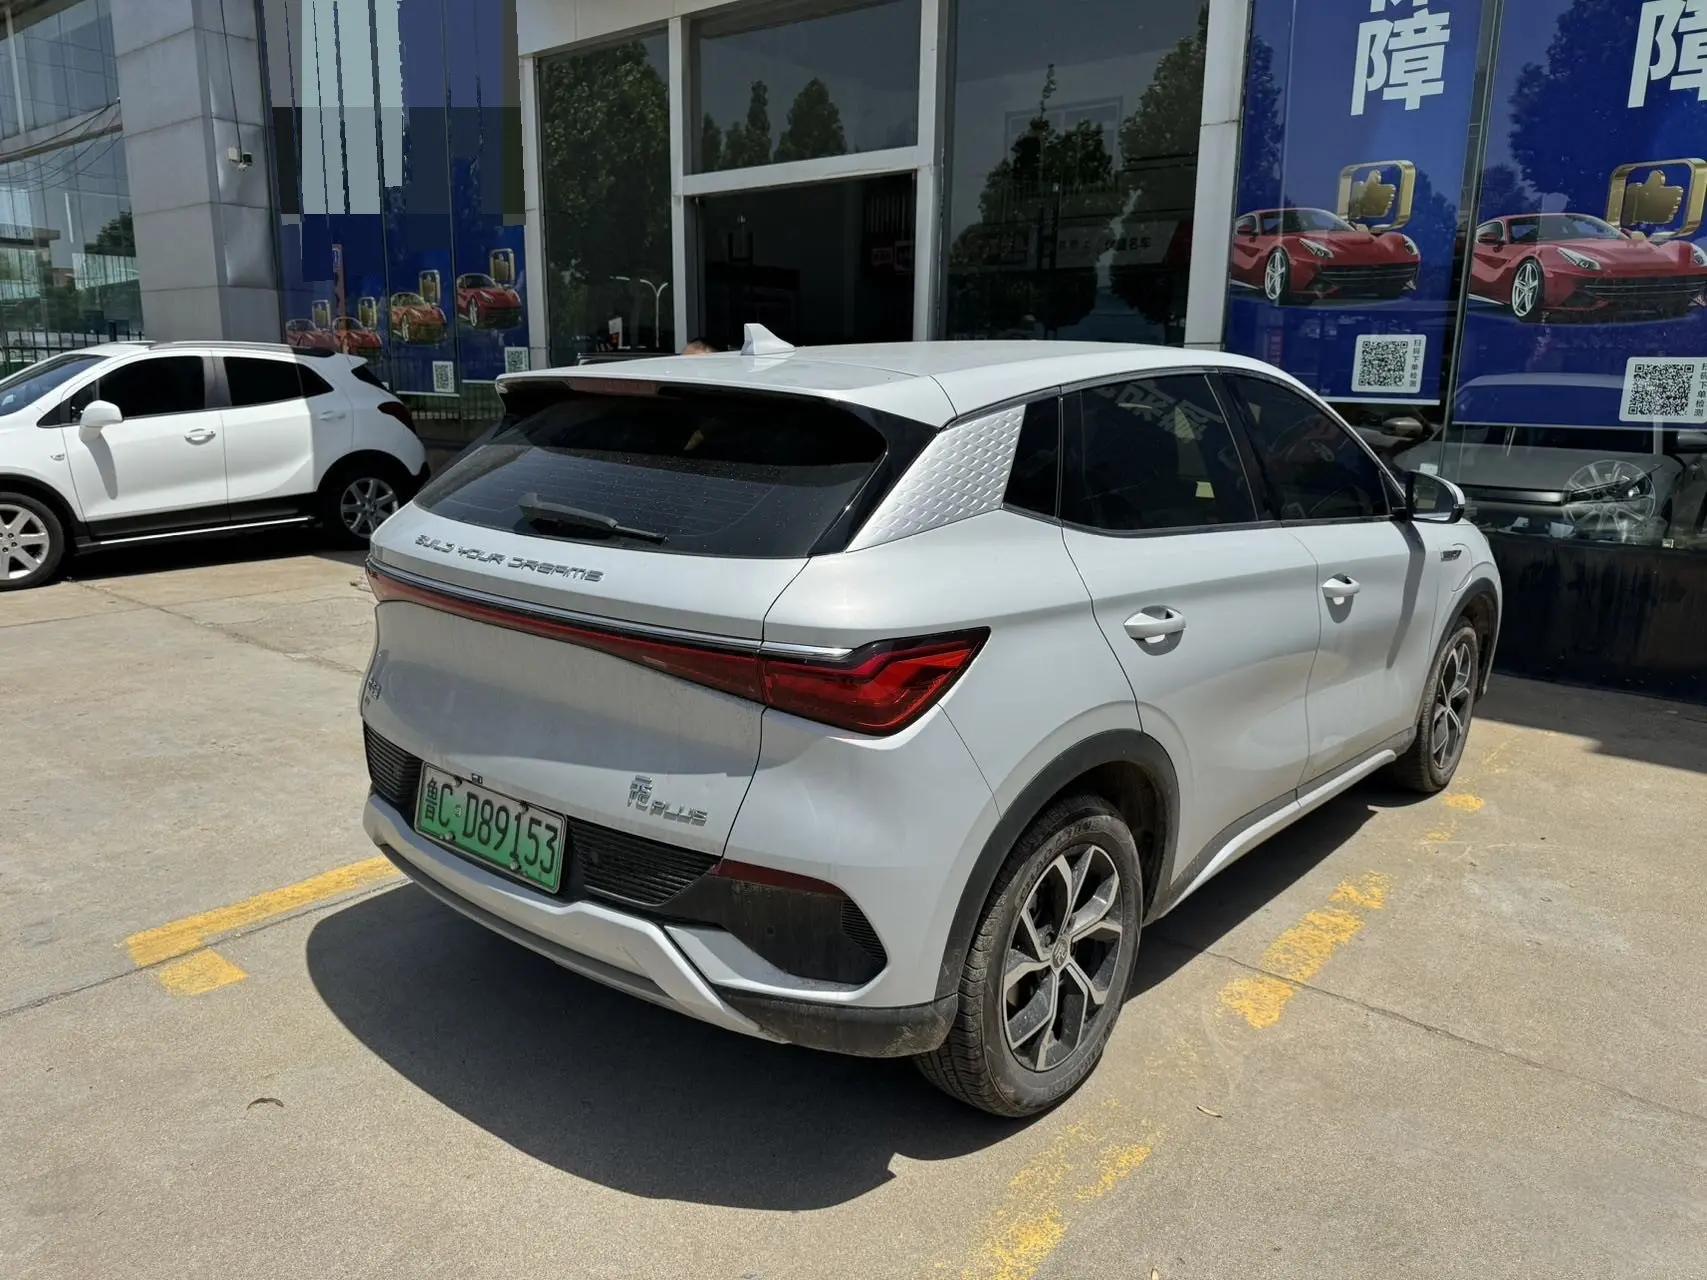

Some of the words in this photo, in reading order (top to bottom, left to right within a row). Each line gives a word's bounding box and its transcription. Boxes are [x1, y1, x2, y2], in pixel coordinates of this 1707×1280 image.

[1351, 0, 1450, 116] 障
[415, 534, 454, 553] BUILD
[458, 546, 505, 565] YOUR
[508, 557, 604, 582] DREAMS
[649, 800, 708, 826] PLUS
